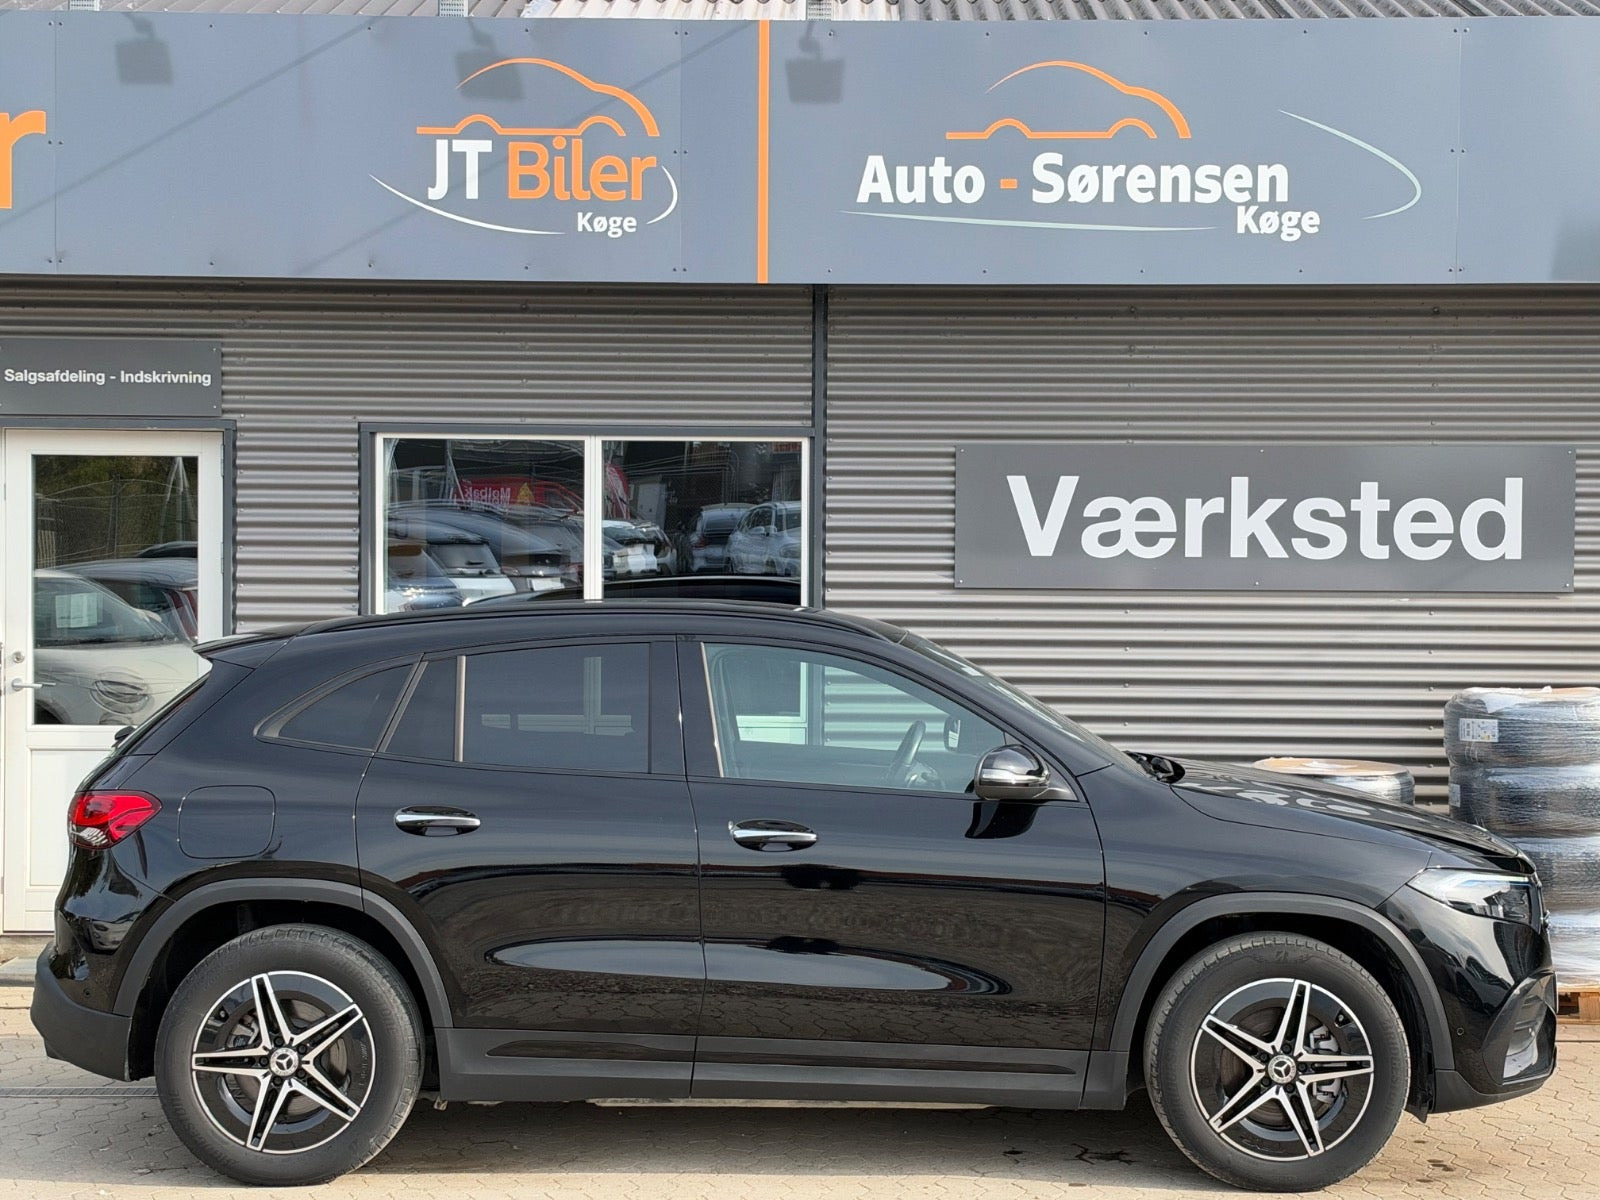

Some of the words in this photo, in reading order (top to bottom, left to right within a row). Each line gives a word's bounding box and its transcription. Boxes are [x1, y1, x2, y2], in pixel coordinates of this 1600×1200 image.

[428, 139, 493, 200] JT
[508, 136, 657, 201] Biler
[857, 155, 985, 203] Auto
[1000, 179, 1018, 189] -
[1032, 153, 1289, 203] Sørensen
[577, 212, 637, 238] Køge
[1236, 206, 1320, 241] Køge
[4, 369, 106, 386] Salgsafdeling
[120, 370, 212, 386] Indskrivning
[1006, 475, 1523, 560] Værksted
